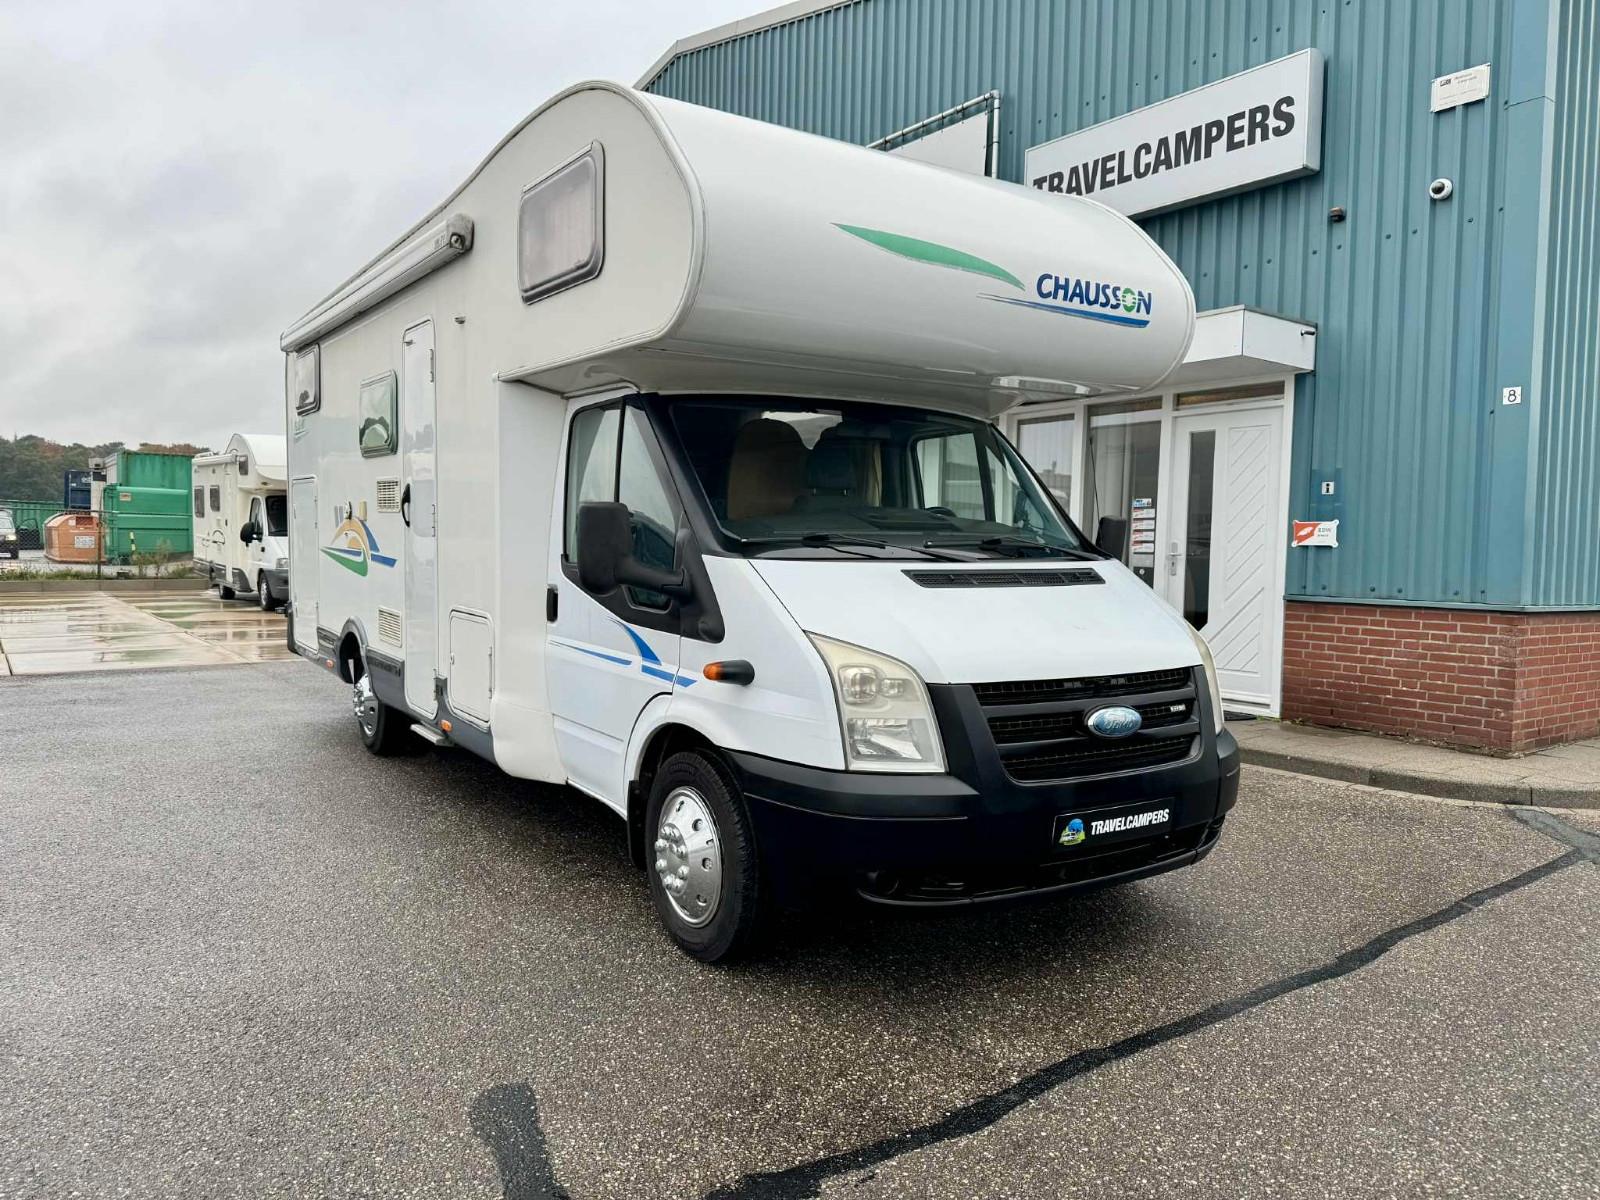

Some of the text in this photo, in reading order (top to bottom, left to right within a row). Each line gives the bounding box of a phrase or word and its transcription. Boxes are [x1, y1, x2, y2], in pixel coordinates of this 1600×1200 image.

[1036, 273, 1153, 315] CHAUSSON
[1507, 389, 1517, 403] 8
[1090, 808, 1170, 836] TRAVELCAMPERS
